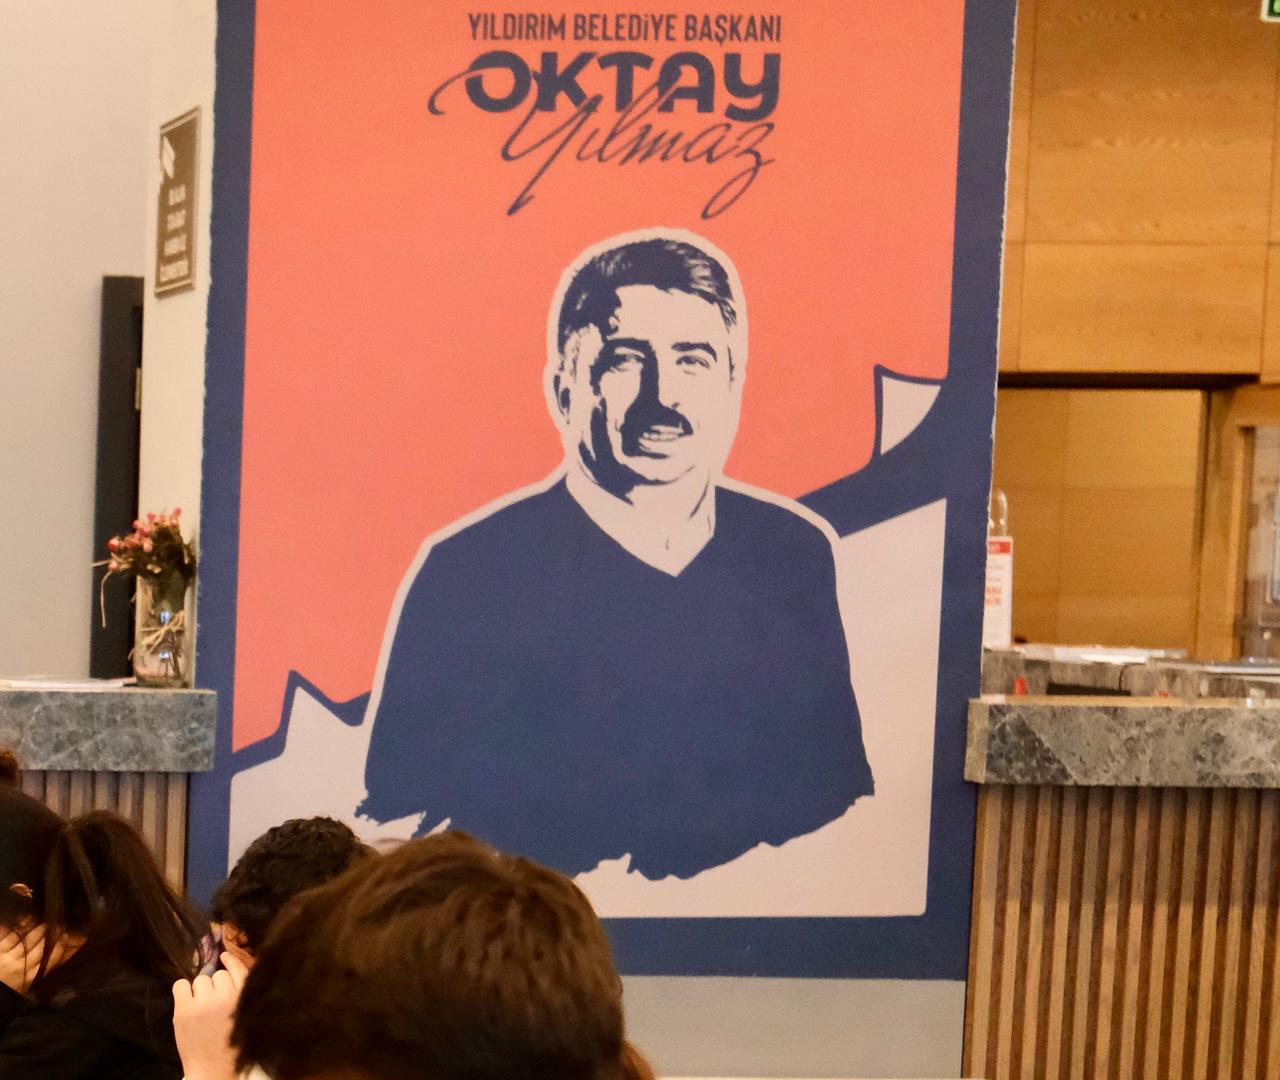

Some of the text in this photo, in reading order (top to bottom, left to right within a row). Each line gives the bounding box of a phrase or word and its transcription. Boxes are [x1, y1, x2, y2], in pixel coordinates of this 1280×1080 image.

[467, 13, 566, 41] YILDIRIM
[684, 14, 782, 46] BAŞKANI
[464, 49, 782, 122] OKTAY
[428, 66, 777, 220] Yılmaz
